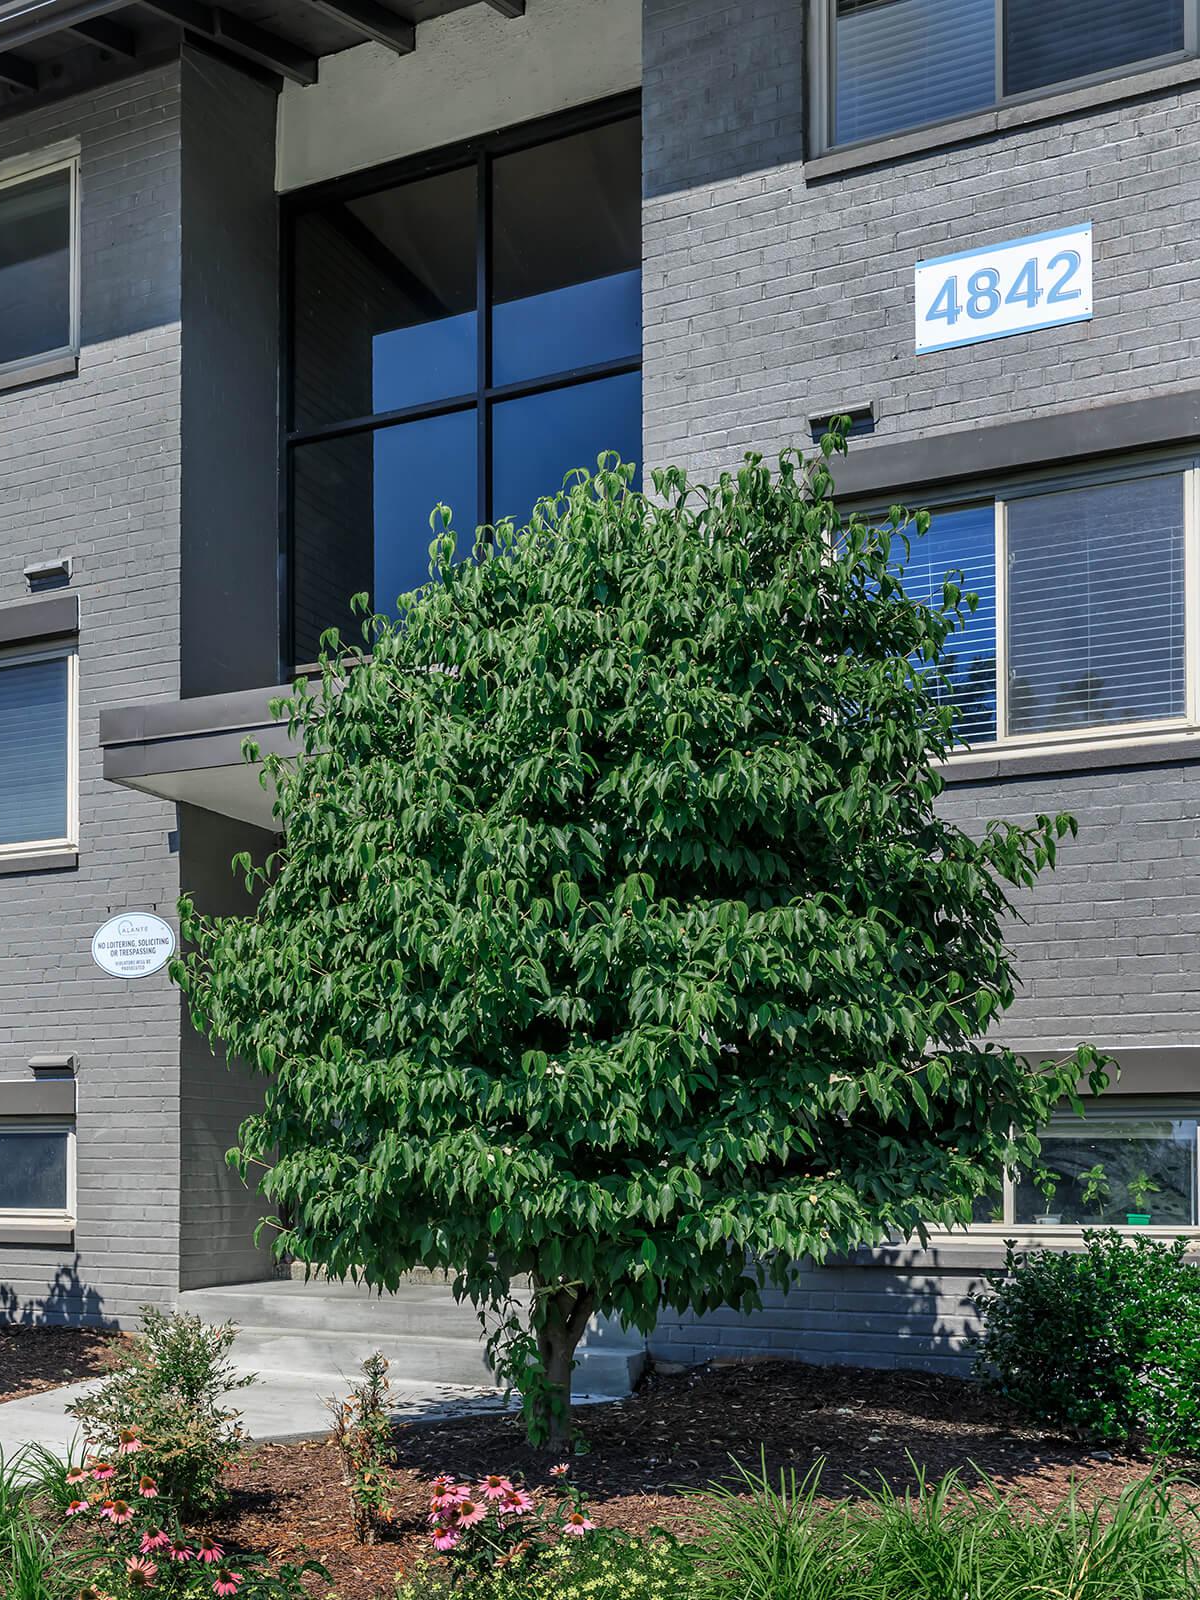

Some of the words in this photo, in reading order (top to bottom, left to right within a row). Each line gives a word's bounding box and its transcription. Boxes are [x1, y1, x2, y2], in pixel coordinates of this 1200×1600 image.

[925, 250, 1082, 326] 4842
[138, 938, 169, 946] SOLICITING
[110, 949, 118, 957] OR
[120, 947, 156, 956] TRESPASSING
